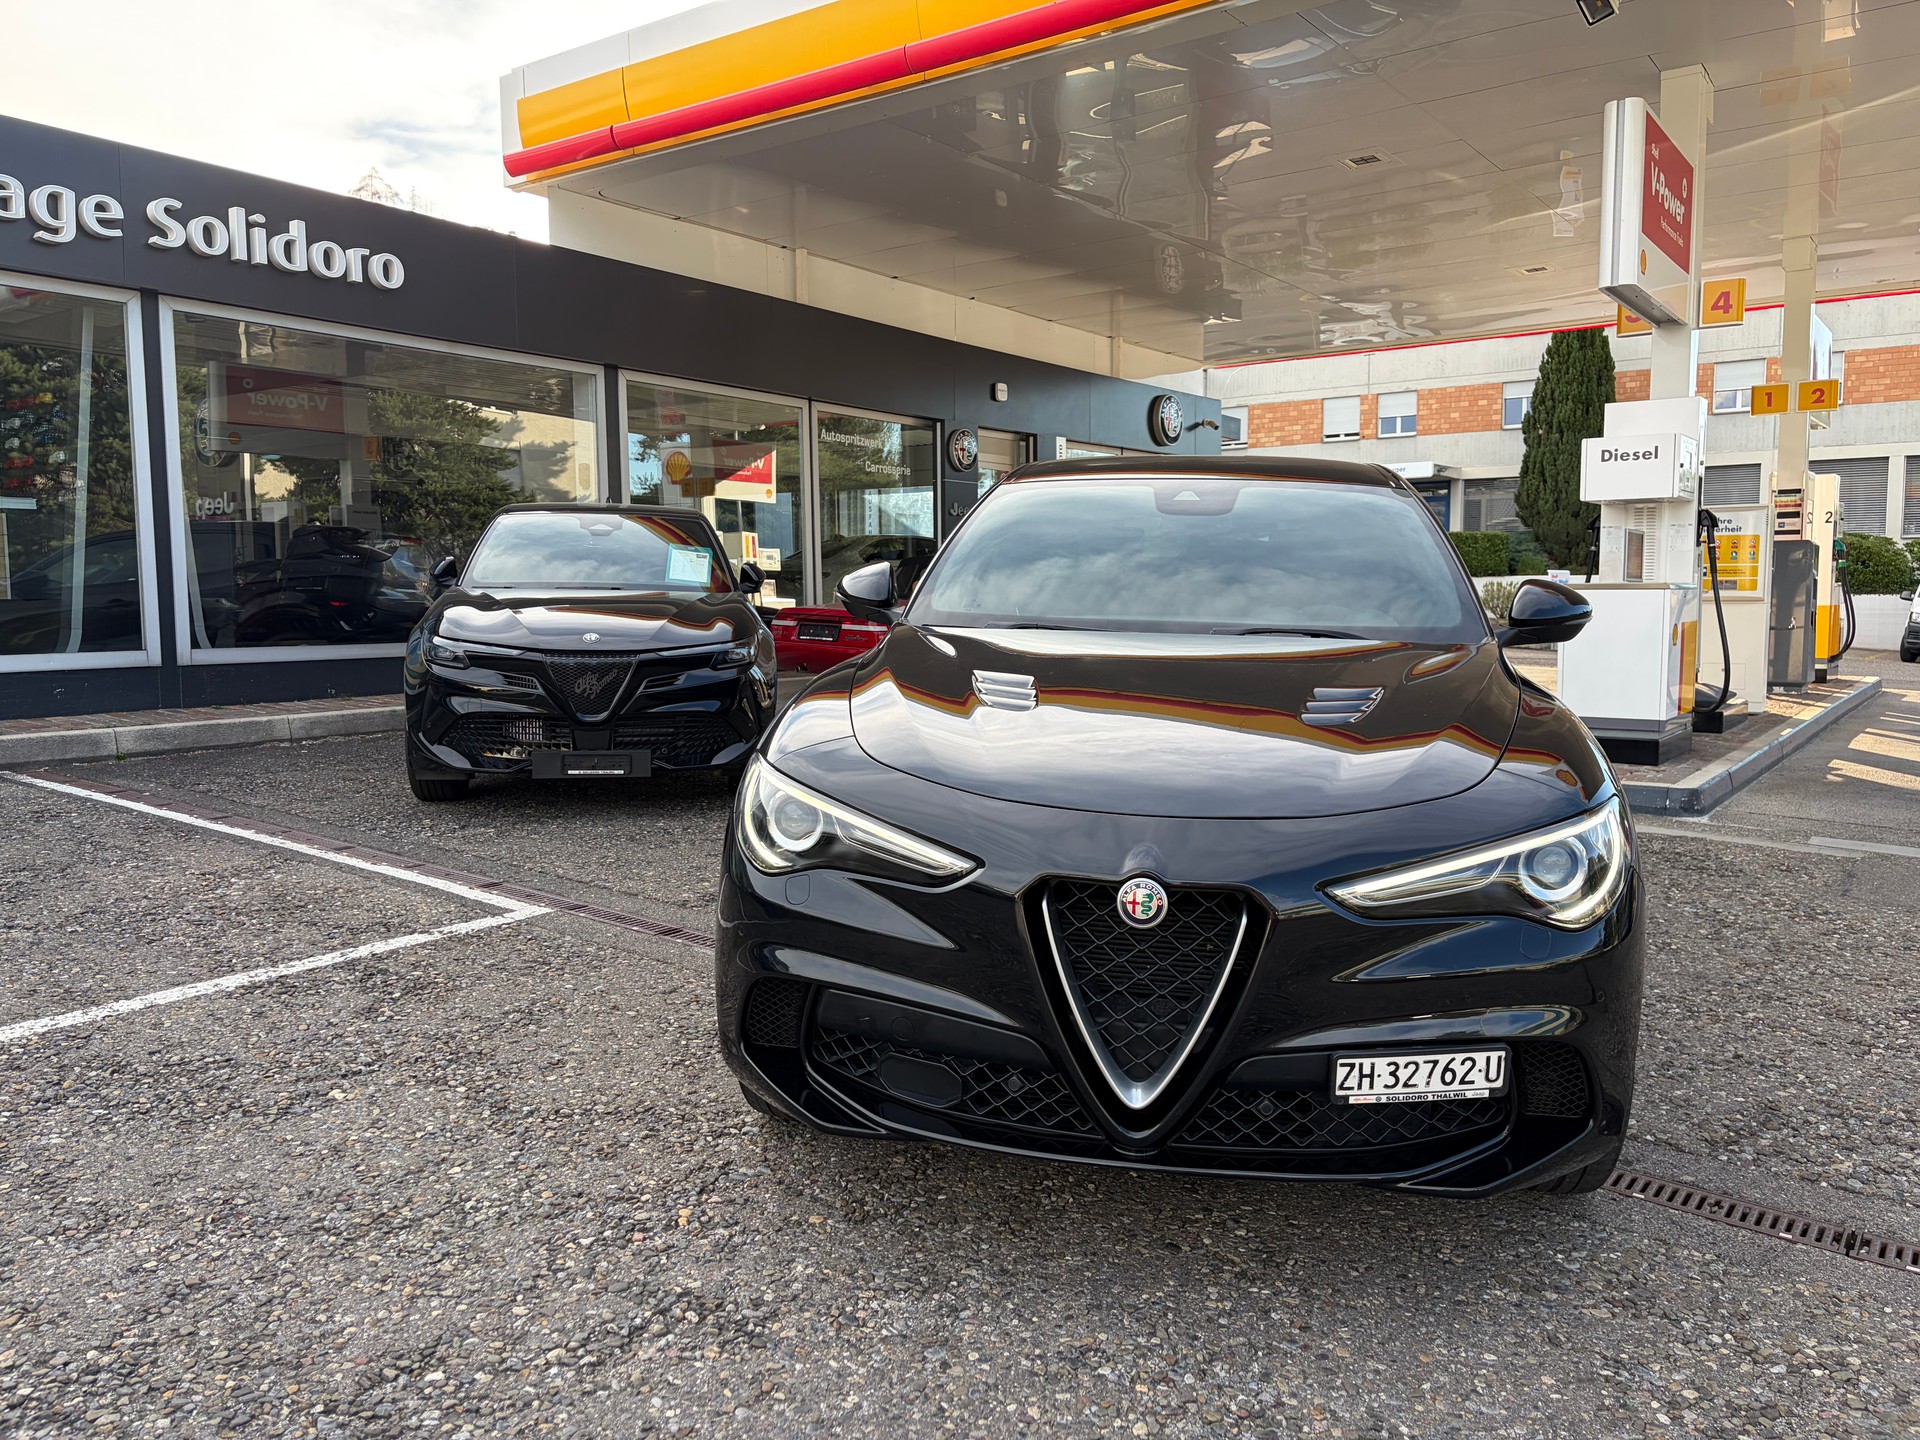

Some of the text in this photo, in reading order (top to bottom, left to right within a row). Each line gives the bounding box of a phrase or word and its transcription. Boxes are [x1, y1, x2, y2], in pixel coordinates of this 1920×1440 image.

[1651, 160, 1685, 225] V-Power
[0, 173, 405, 290] age Solidoro
[1710, 290, 1733, 314] 4
[1764, 391, 1773, 408] 1
[1811, 388, 1825, 404] 2
[820, 428, 883, 448] Autospritzwerk
[1600, 445, 1659, 462] Diesel
[865, 461, 911, 476] Carrosserie
[950, 502, 969, 516] Jee
[1825, 511, 1833, 523] 2
[1717, 517, 1733, 525] hre
[1122, 883, 1163, 906] ALFA ROMEO
[1386, 1094, 1429, 1102] SOLIDORO
[1431, 1092, 1468, 1100] THALWIL
